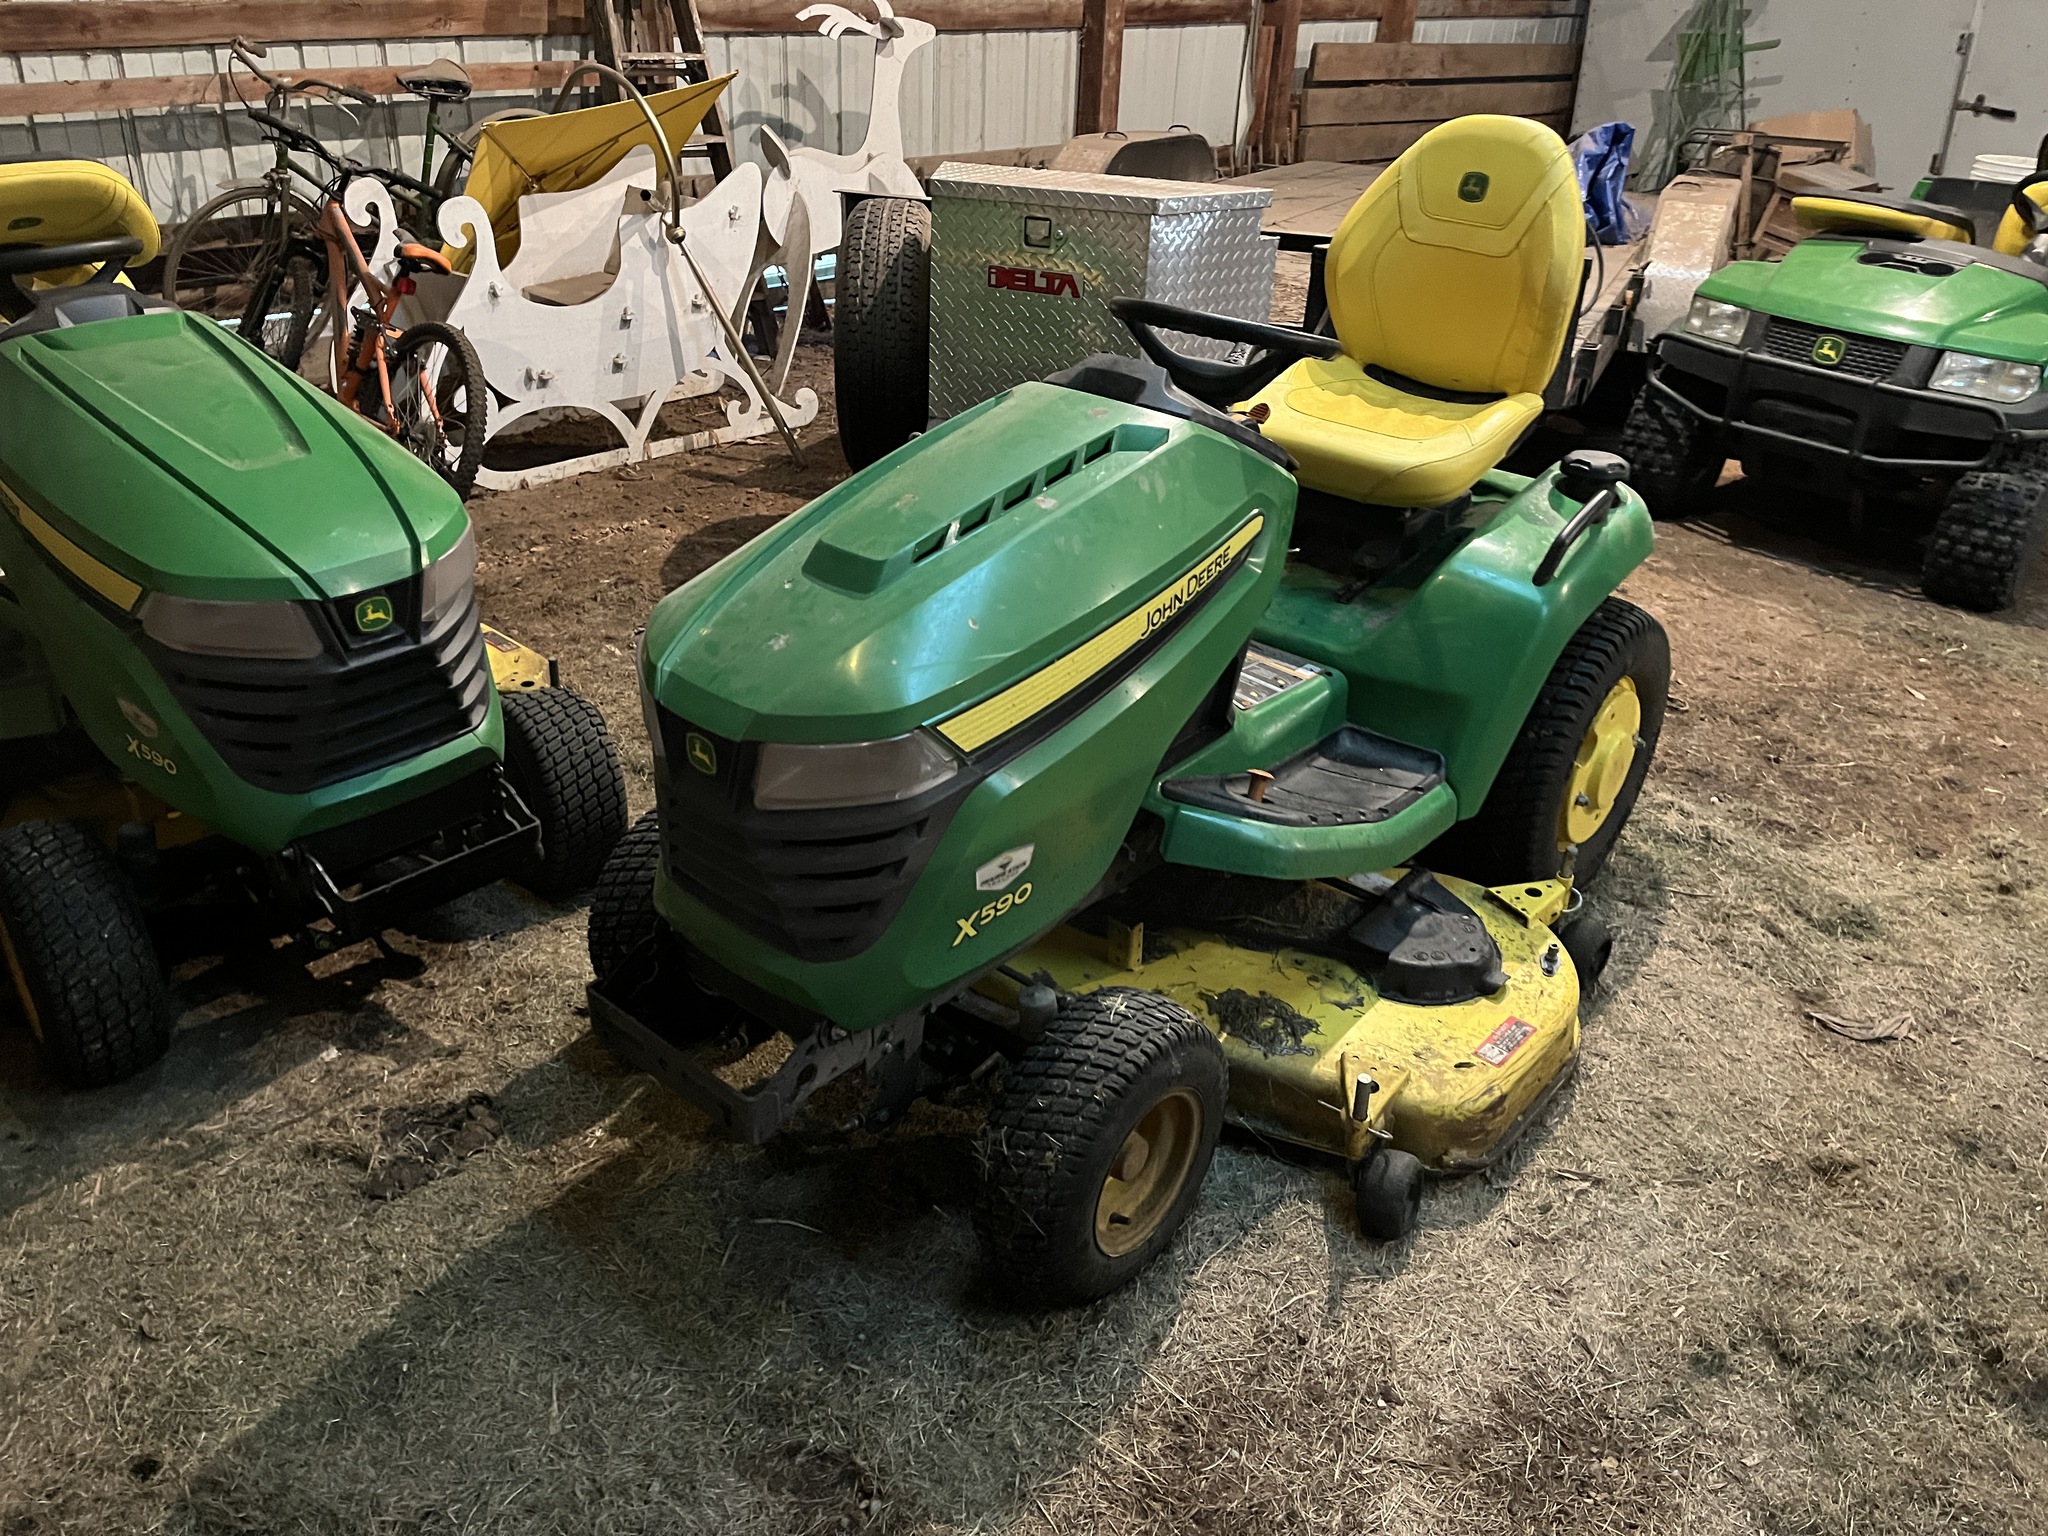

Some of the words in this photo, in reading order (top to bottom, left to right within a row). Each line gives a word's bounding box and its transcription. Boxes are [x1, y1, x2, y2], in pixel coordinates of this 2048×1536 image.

[988, 265, 1081, 299] DELTA
[1141, 585, 1184, 637] JOHN
[1186, 545, 1231, 599] DEERE
[125, 733, 177, 775] X590
[952, 882, 1033, 947] X590
